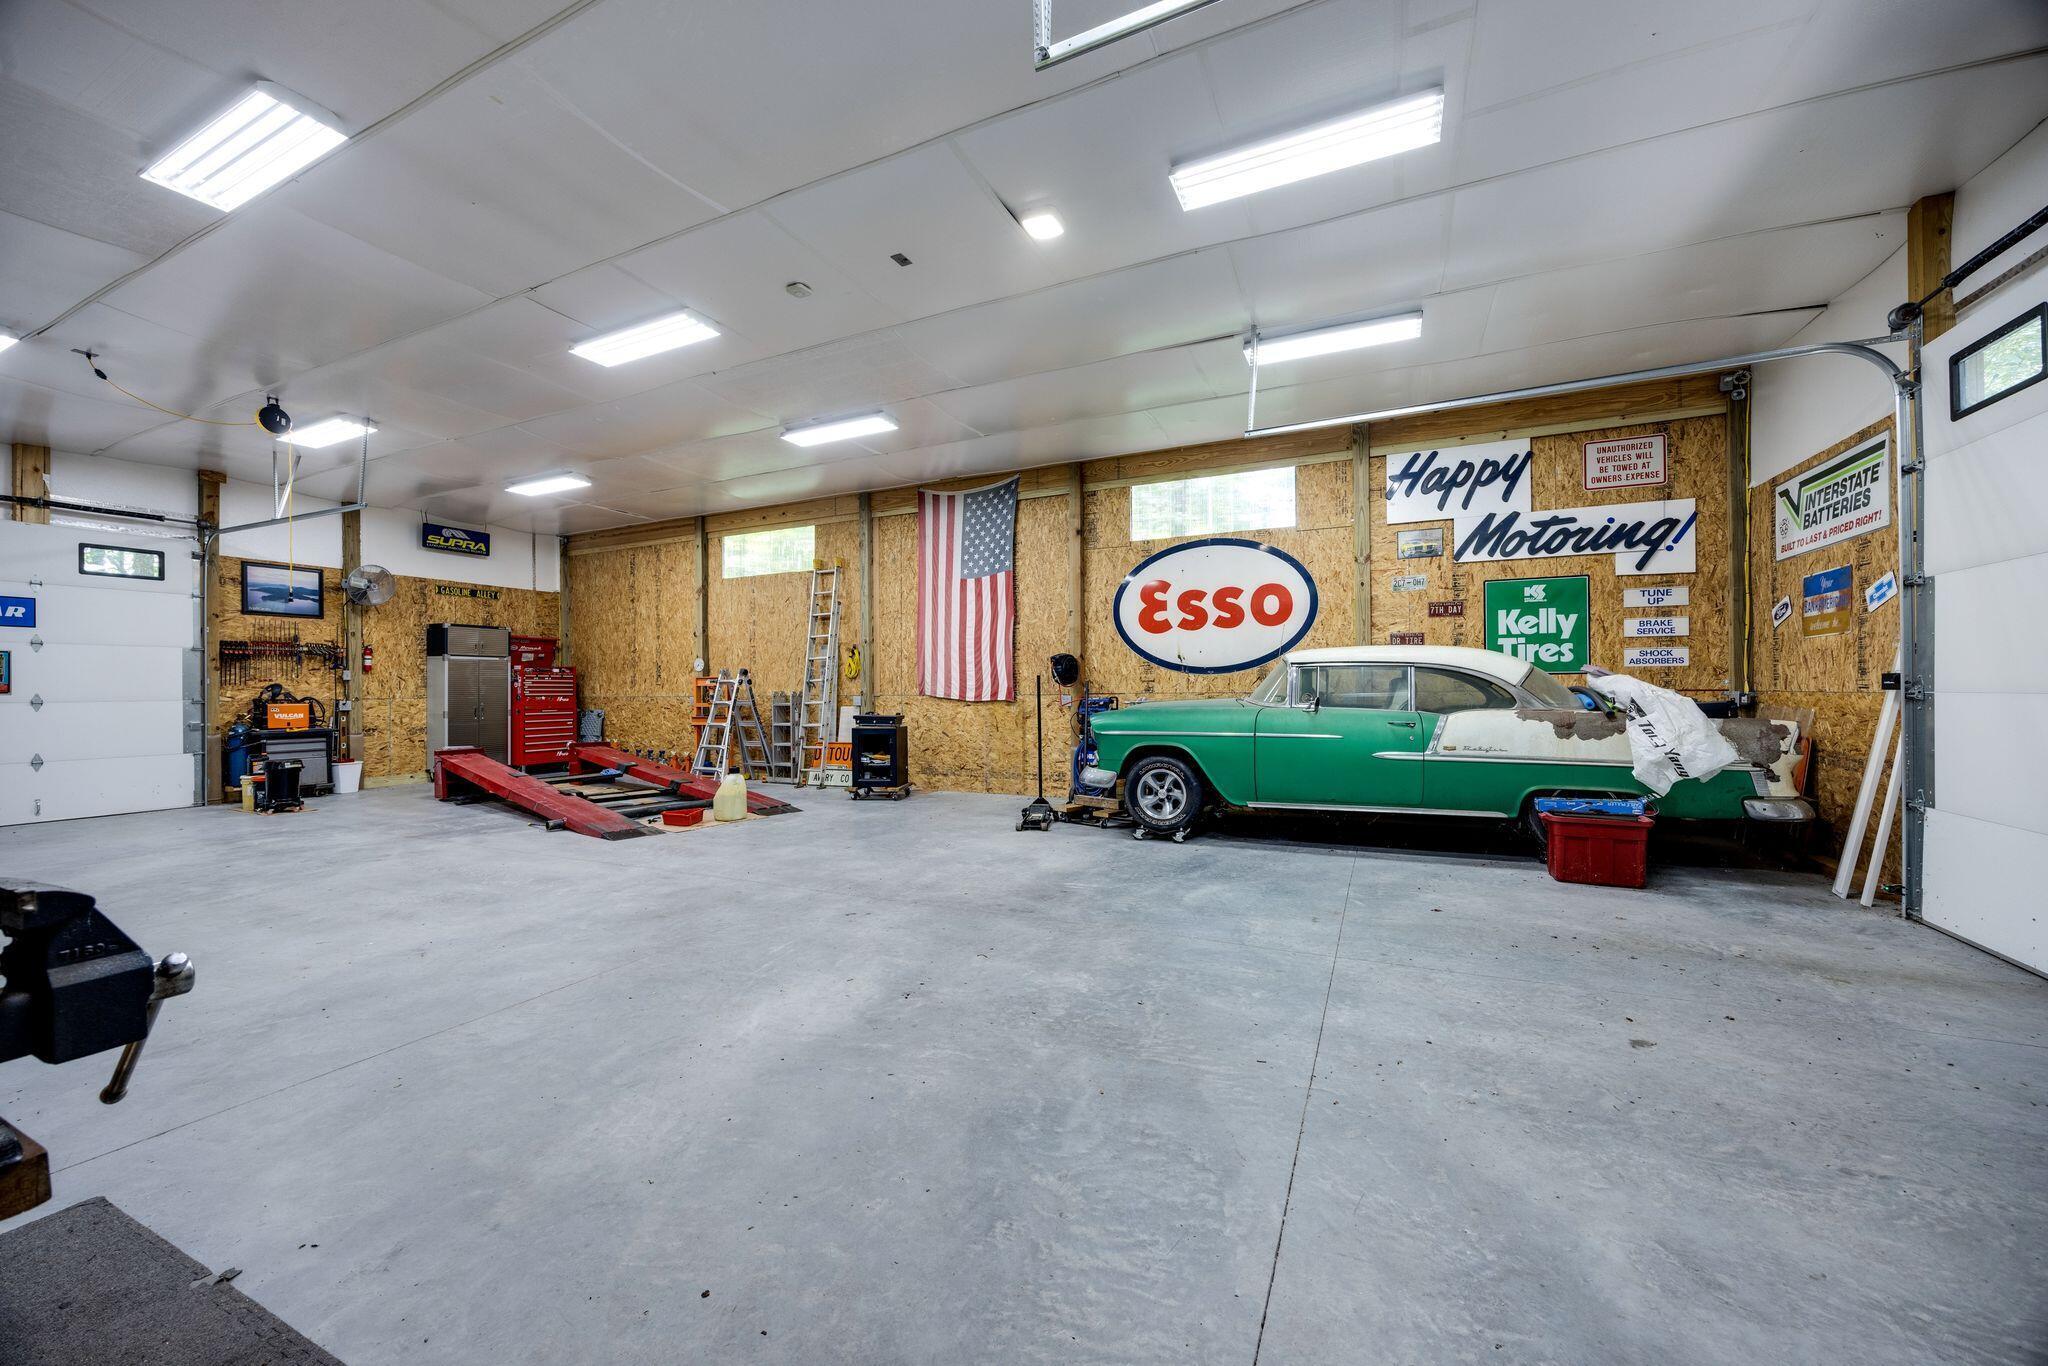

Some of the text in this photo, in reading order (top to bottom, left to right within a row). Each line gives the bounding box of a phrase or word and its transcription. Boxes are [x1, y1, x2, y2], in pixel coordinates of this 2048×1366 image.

[1596, 441, 1653, 455] UNAUTHORIZED
[1596, 452, 1654, 464] VEHICLES WILL
[1599, 461, 1651, 474] BE TOWED AT
[1385, 450, 1533, 512] Happy
[1591, 470, 1660, 485] OWNERS EXPENSE
[1804, 461, 1881, 512] INTERSTATE
[1802, 487, 1871, 531] BATTERIES
[1780, 541, 1796, 553] BUILT
[1796, 537, 1805, 548] TO
[1805, 531, 1822, 545] LAST
[1828, 520, 1854, 537] PRICED
[1855, 509, 1882, 528] RIGHT!
[426, 534, 487, 552] SUPRA
[1453, 511, 1698, 572] Motoring!
[440, 585, 496, 599] GASOLINE ALLEY
[1640, 588, 1673, 597] TUNE
[1647, 597, 1664, 605] UP
[1430, 605, 1462, 615] 7TH DAY
[1497, 607, 1579, 639] Kelly
[1638, 619, 1673, 627] BRAKE
[1636, 627, 1676, 635] SERVICE
[1405, 636, 1423, 645] TIRE
[1497, 637, 1575, 663] Tires
[1638, 649, 1674, 657] SHOCK
[1628, 657, 1685, 665] ABSORBERS
[814, 746, 852, 762] DTOU
[813, 772, 834, 783] ARY
